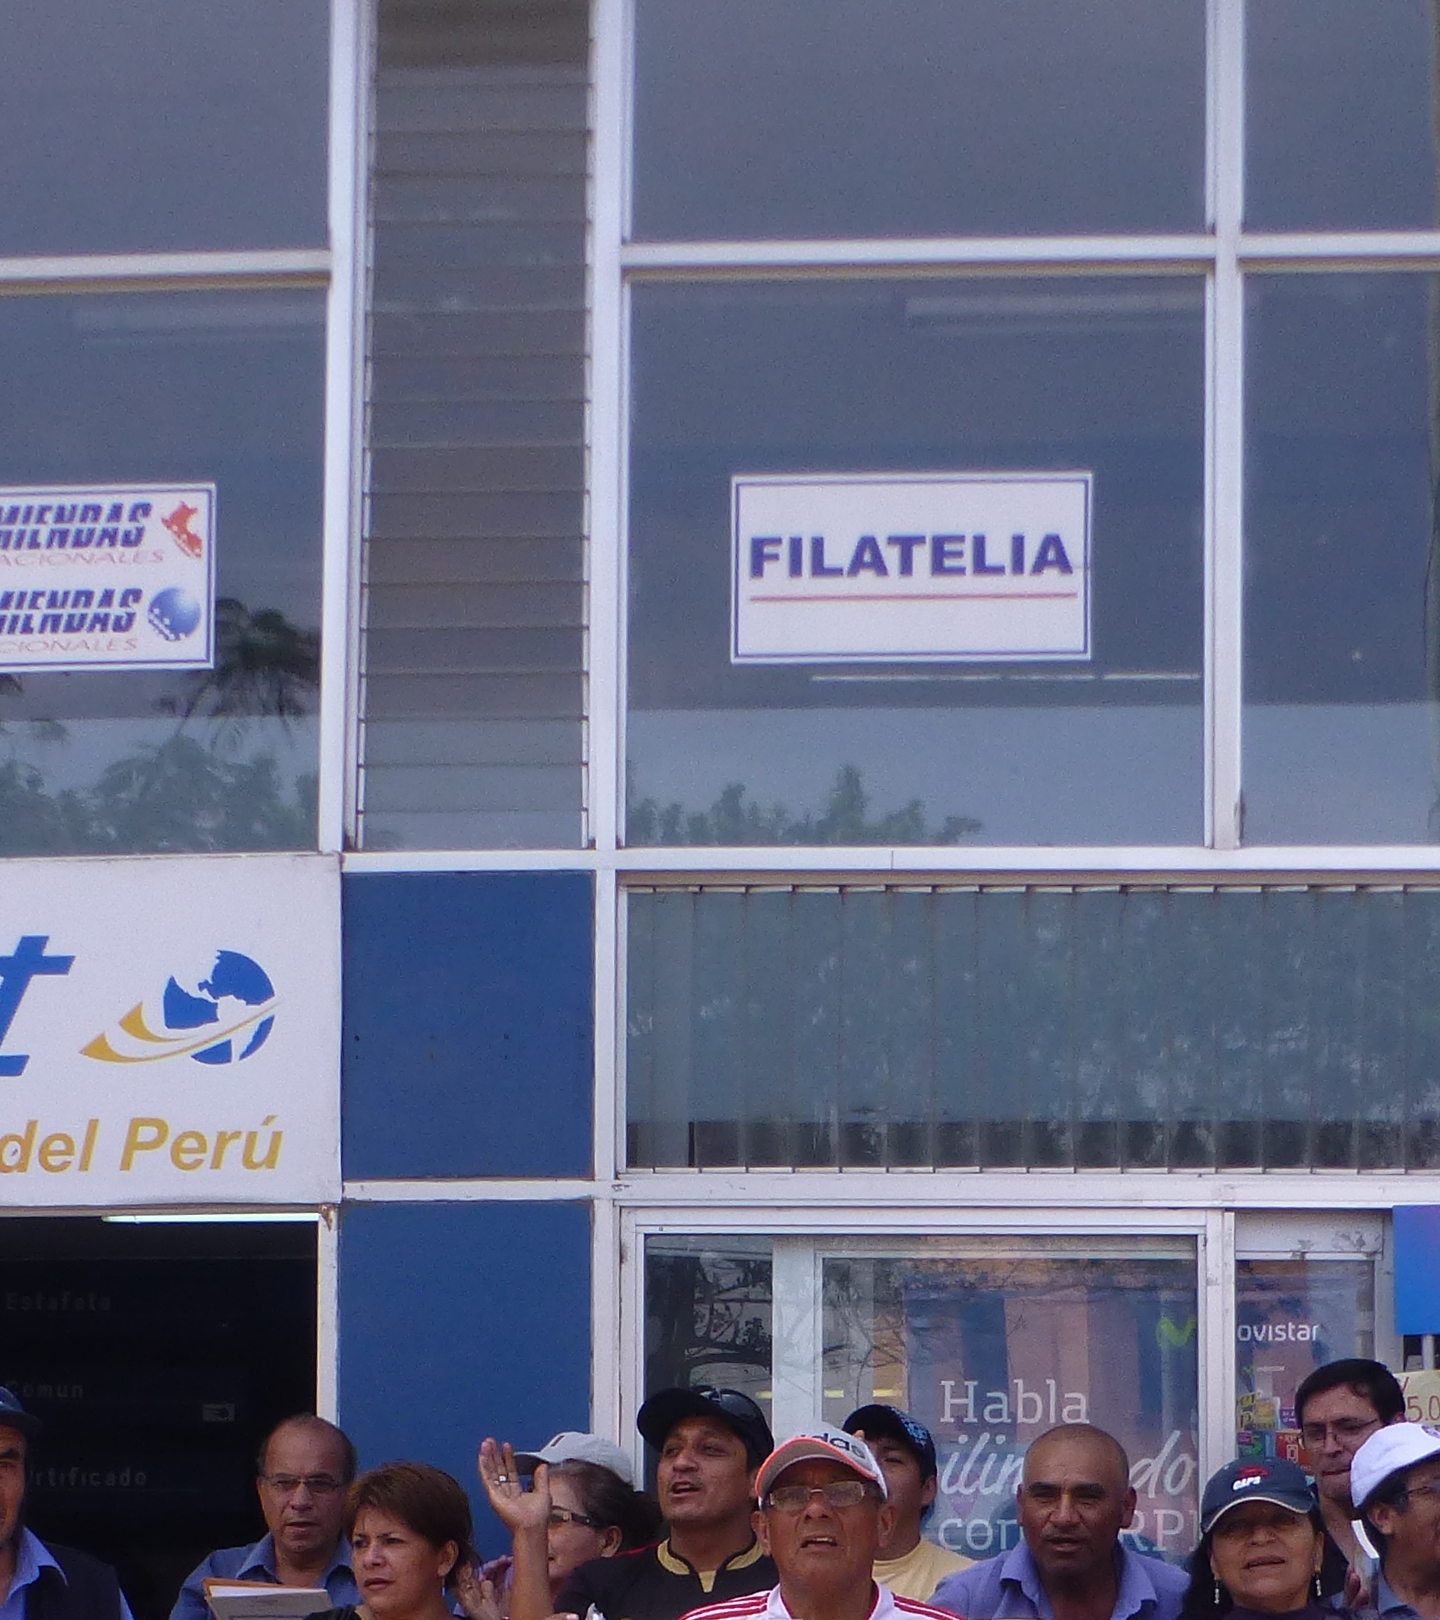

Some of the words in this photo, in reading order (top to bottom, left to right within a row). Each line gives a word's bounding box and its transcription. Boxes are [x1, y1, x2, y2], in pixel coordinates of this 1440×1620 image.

[749, 533, 1075, 578] FILATELIA
[120, 1113, 285, 1177] Perú
[1237, 1321, 1319, 1341] ovistar
[939, 1378, 1091, 1424] Habla
[29, 1466, 148, 1488] rtificado
